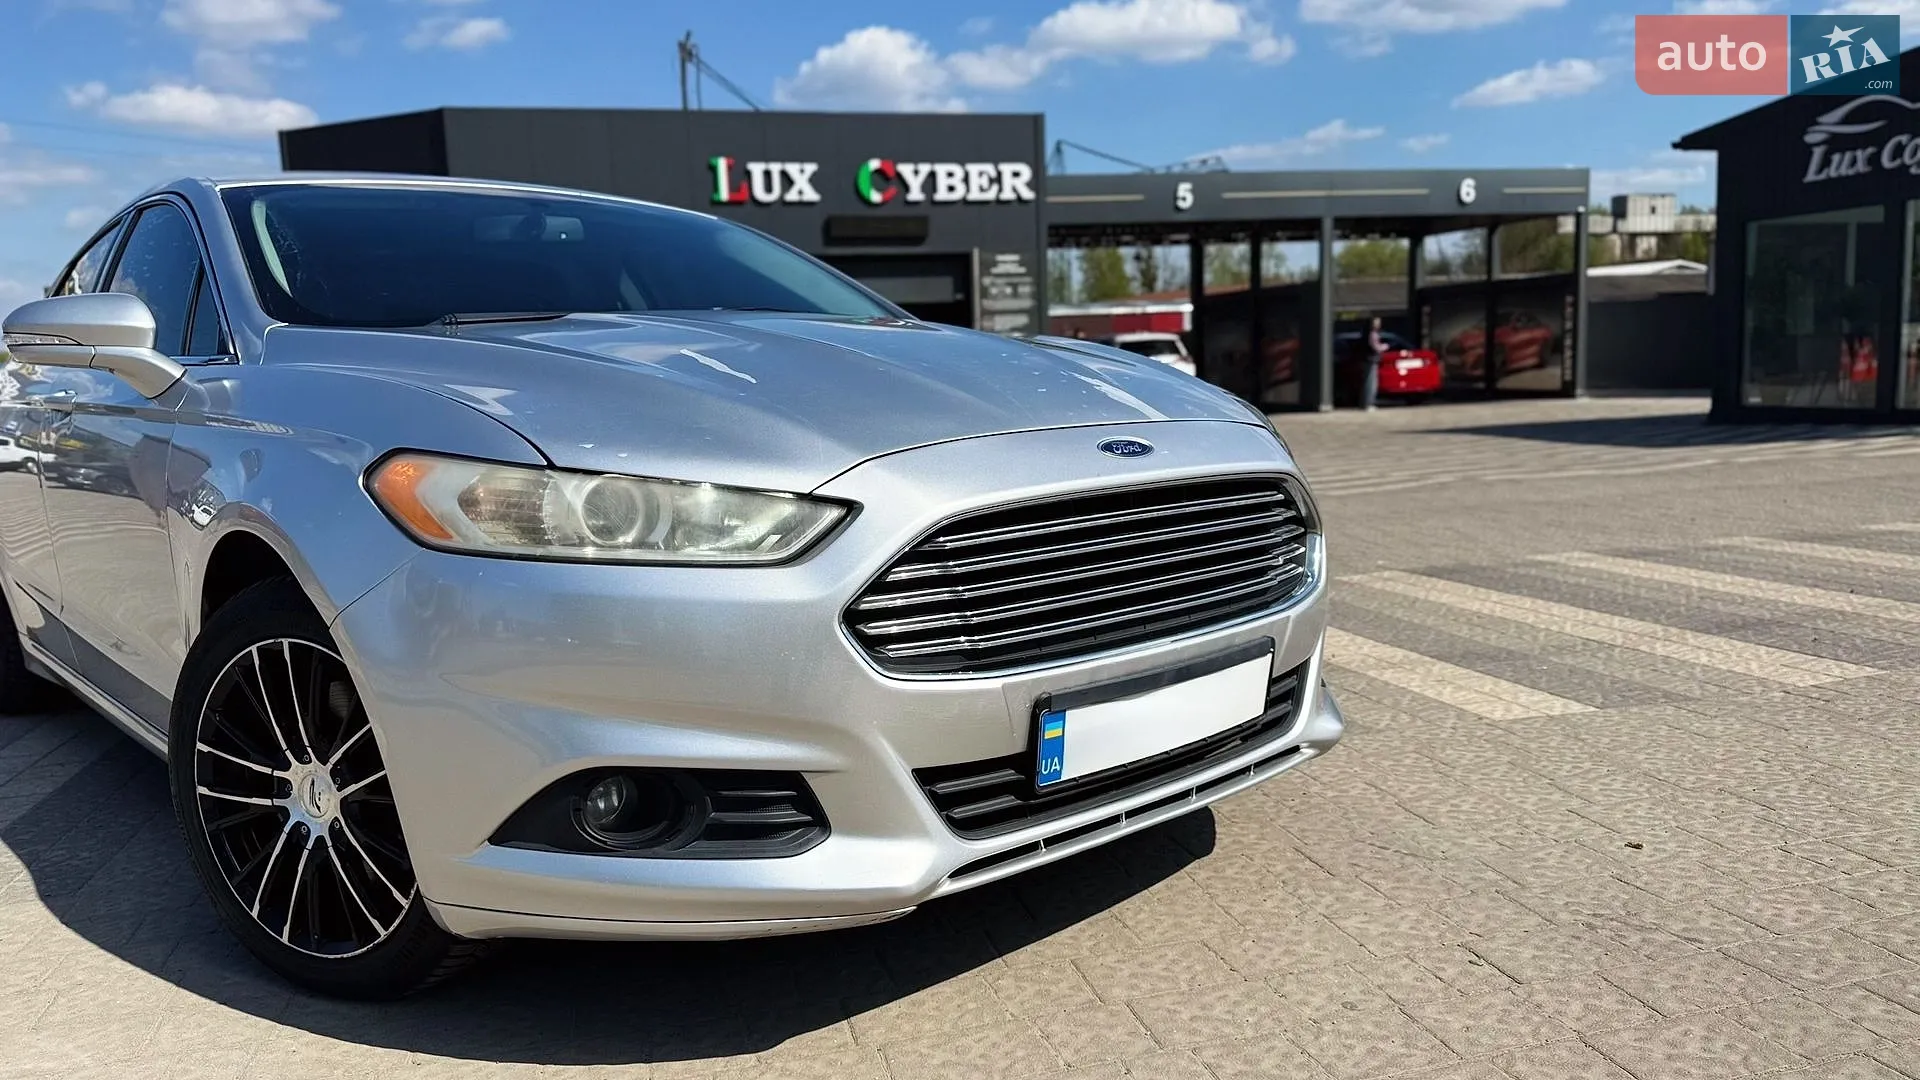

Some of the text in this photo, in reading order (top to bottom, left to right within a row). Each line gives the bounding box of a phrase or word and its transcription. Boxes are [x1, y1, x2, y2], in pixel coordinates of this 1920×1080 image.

[1802, 134, 1920, 183] Lux Co
[709, 155, 1035, 204] LUX CYBER
[1459, 178, 1477, 204] 6
[1176, 182, 1194, 209] 5
[1112, 441, 1143, 454] Ford
[1041, 759, 1061, 775] UA
